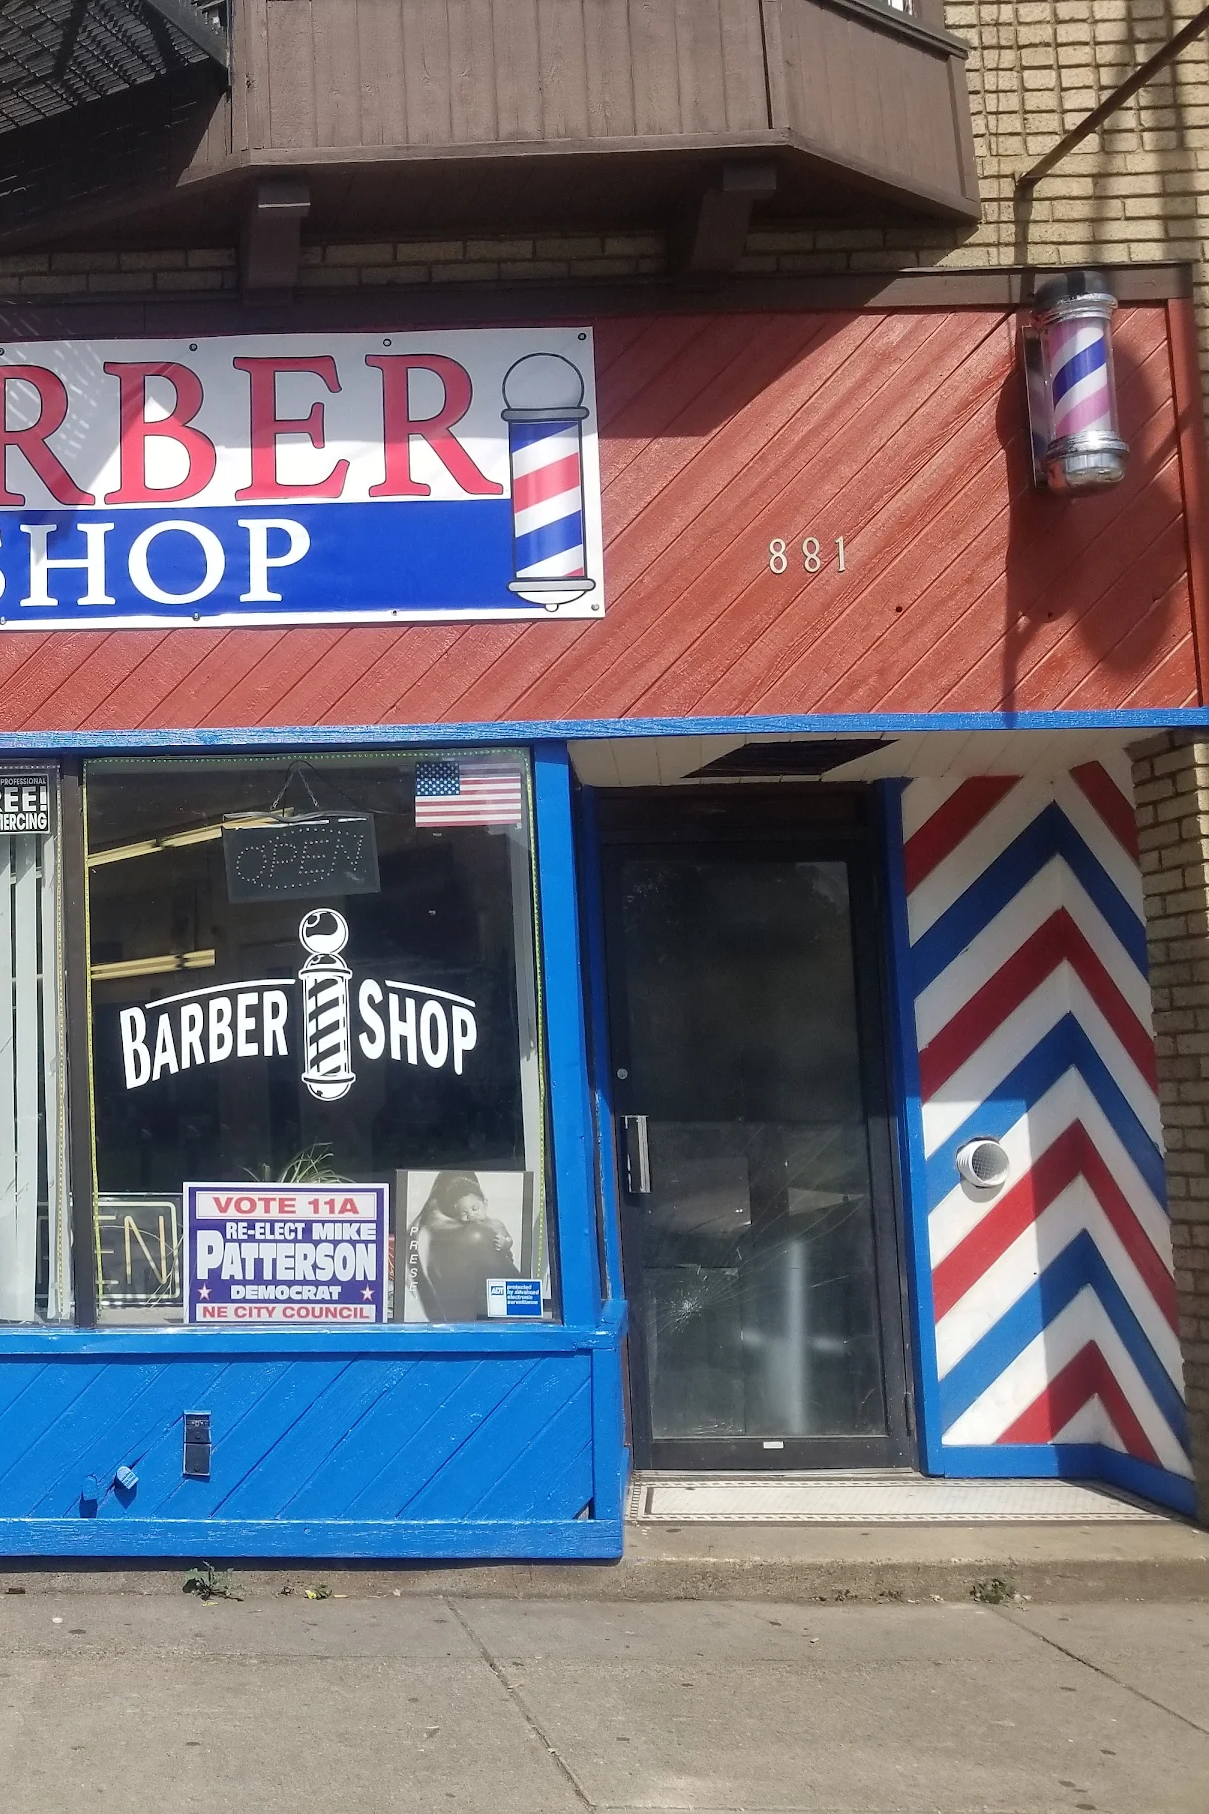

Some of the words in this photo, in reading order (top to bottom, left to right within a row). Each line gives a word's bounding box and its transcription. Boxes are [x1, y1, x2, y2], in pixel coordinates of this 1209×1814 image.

[769, 535, 846, 574] 881
[236, 832, 364, 880] OPEN
[119, 989, 289, 1090] BARBER
[358, 979, 478, 1076] SHOP
[212, 1196, 297, 1215] VOTE
[308, 1197, 360, 1215] 11A
[225, 1222, 306, 1240] RE-ELECT
[312, 1222, 377, 1241] MIKE
[196, 1229, 377, 1282] PATTERSON
[230, 1284, 342, 1300] DEMOCRAT
[202, 1306, 228, 1319] NE
[233, 1306, 277, 1319] CITY
[281, 1306, 370, 1320] COUNCIL
